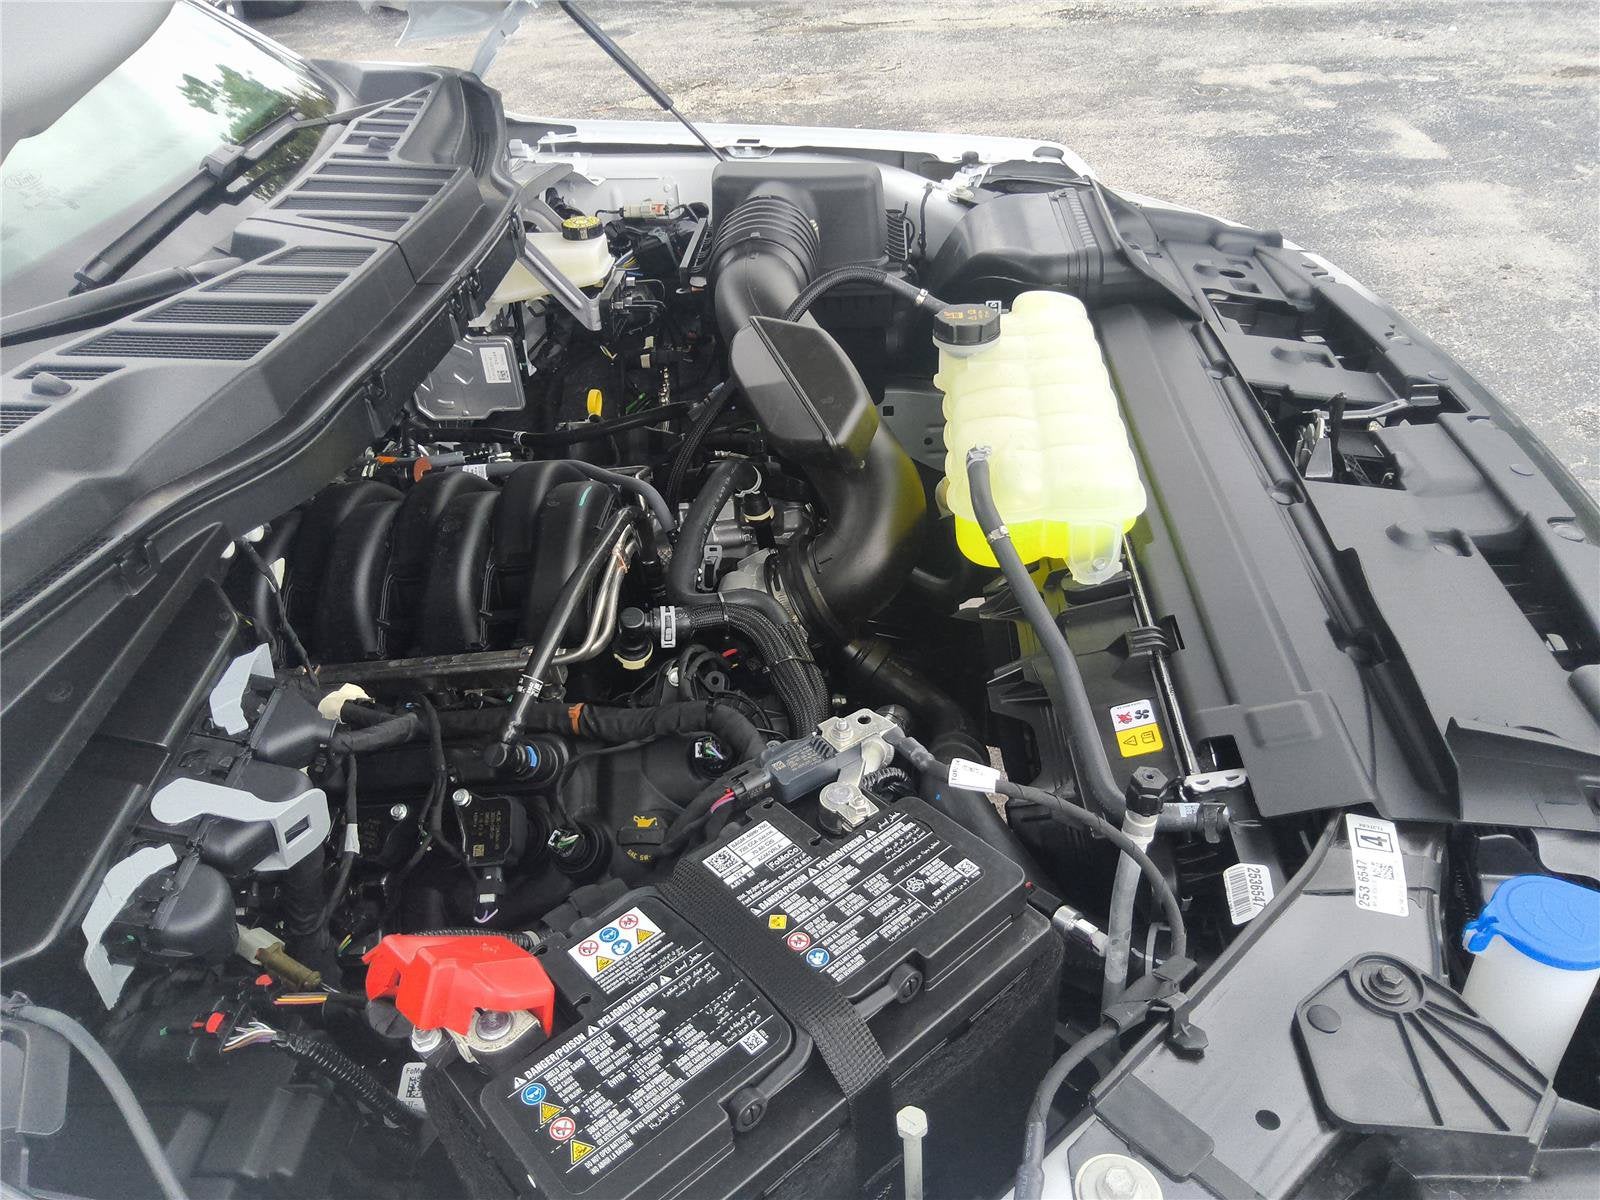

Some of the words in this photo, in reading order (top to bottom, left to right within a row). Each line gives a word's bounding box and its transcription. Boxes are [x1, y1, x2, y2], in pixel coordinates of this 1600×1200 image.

[1360, 835, 1387, 847] 4
[767, 846, 800, 868] FoMoCo
[814, 834, 867, 870] PELIGRO/VENENO
[1356, 859, 1370, 882] 6547
[756, 873, 810, 910] DANGER/POISON
[1247, 867, 1267, 907] 2536547
[1359, 886, 1370, 907] 253
[596, 981, 660, 1028] PELIGRO/VENENO
[663, 1036, 674, 1046] NO
[523, 1031, 587, 1080] DANGER/POISON
[605, 1069, 628, 1088] ÉVITER
[582, 1090, 602, 1106] SPARKS
[586, 1095, 606, 1111] FLAMES
[591, 1098, 613, 1117] SMOKING
[569, 1104, 581, 1115] NO
